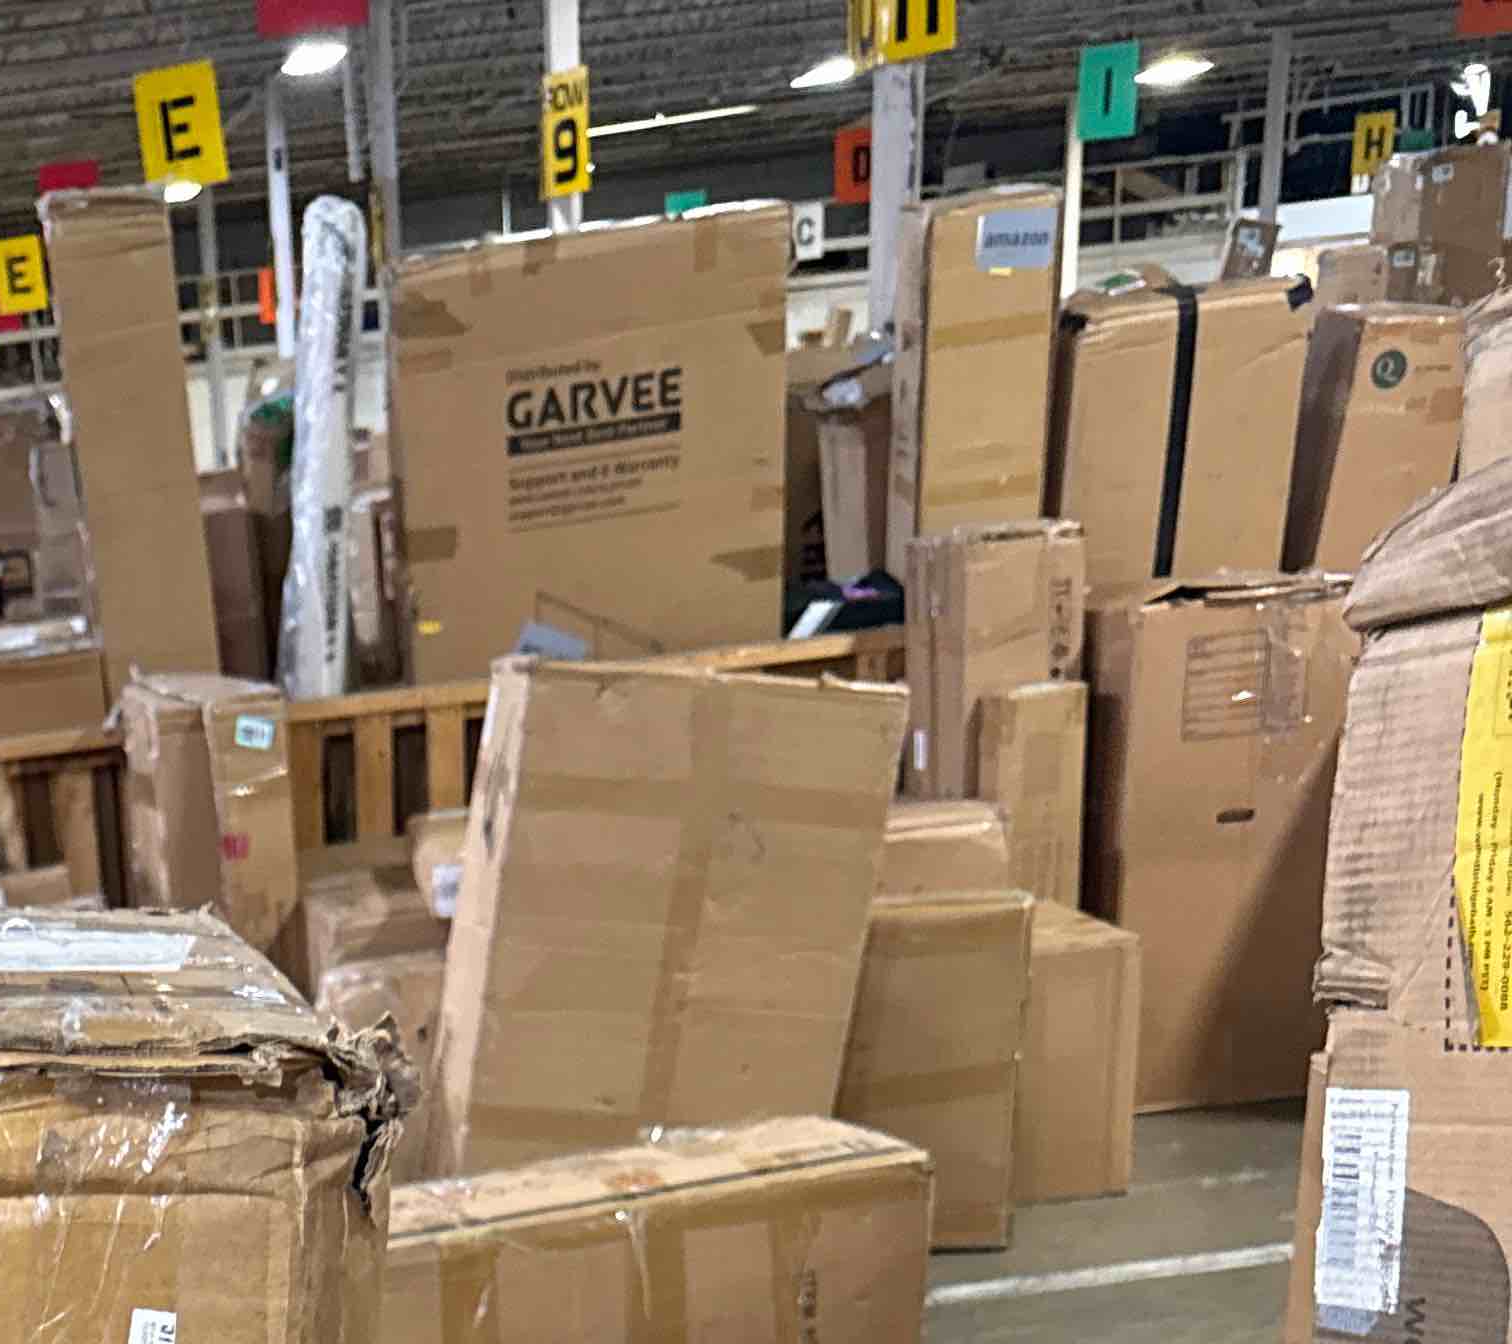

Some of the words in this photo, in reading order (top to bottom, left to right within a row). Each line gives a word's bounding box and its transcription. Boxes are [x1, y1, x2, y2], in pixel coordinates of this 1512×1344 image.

[159, 95, 201, 162] E
[1363, 126, 1386, 161] H
[554, 118, 578, 183] 9
[796, 217, 816, 246] C
[982, 230, 1049, 249] amazon
[5, 255, 32, 295] E
[506, 367, 683, 430] GARVEE
